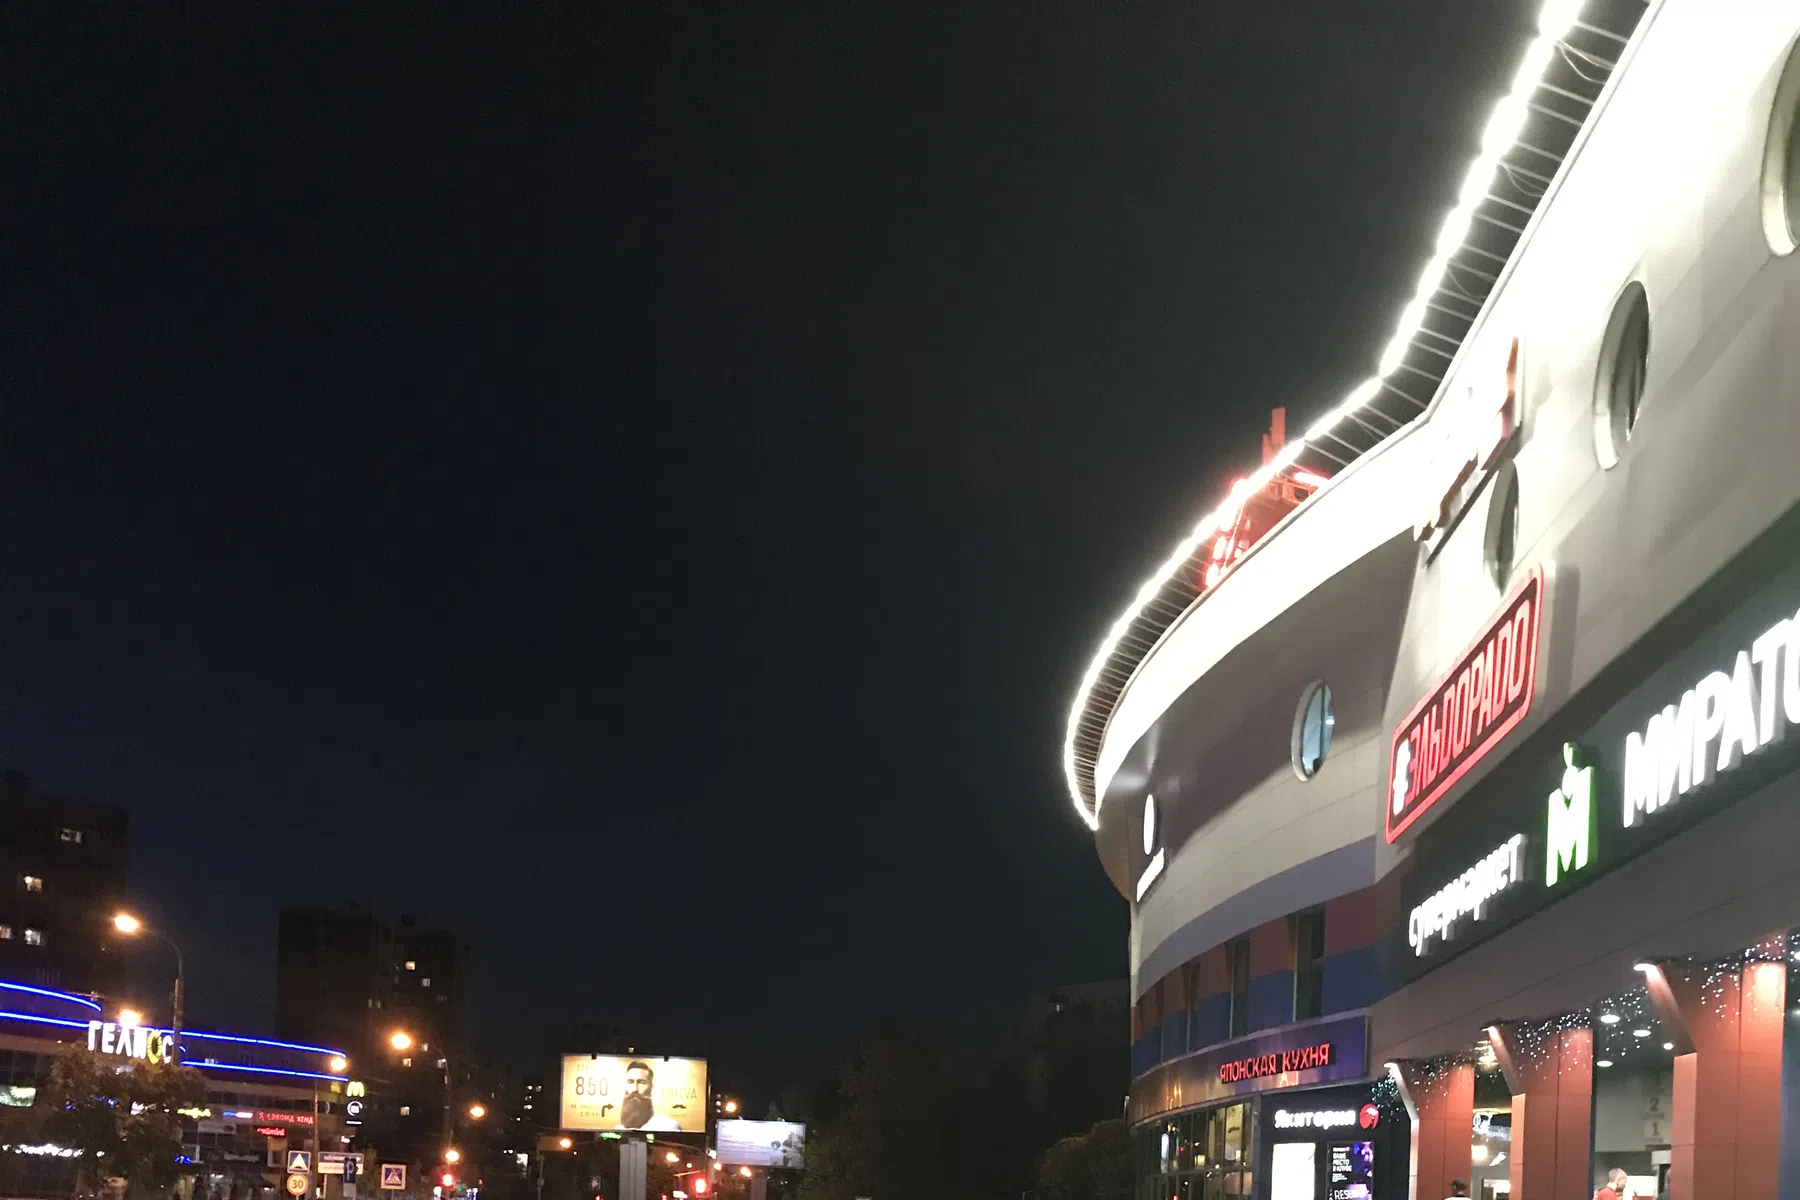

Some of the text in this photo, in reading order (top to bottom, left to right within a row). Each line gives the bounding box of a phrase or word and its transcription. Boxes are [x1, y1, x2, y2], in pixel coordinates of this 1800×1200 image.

[1408, 832, 1524, 957] супермаркет
[88, 1020, 174, 1064] ГЕЛИОС
[1220, 1042, 1330, 1083] ЯПОНСКАЯ КУХНЯ
[575, 1076, 608, 1096] 850
[266, 1113, 314, 1125] СЭКОНД ХЕНД
[1274, 1109, 1356, 1130] Якитория
[291, 1179, 303, 1189] 30
